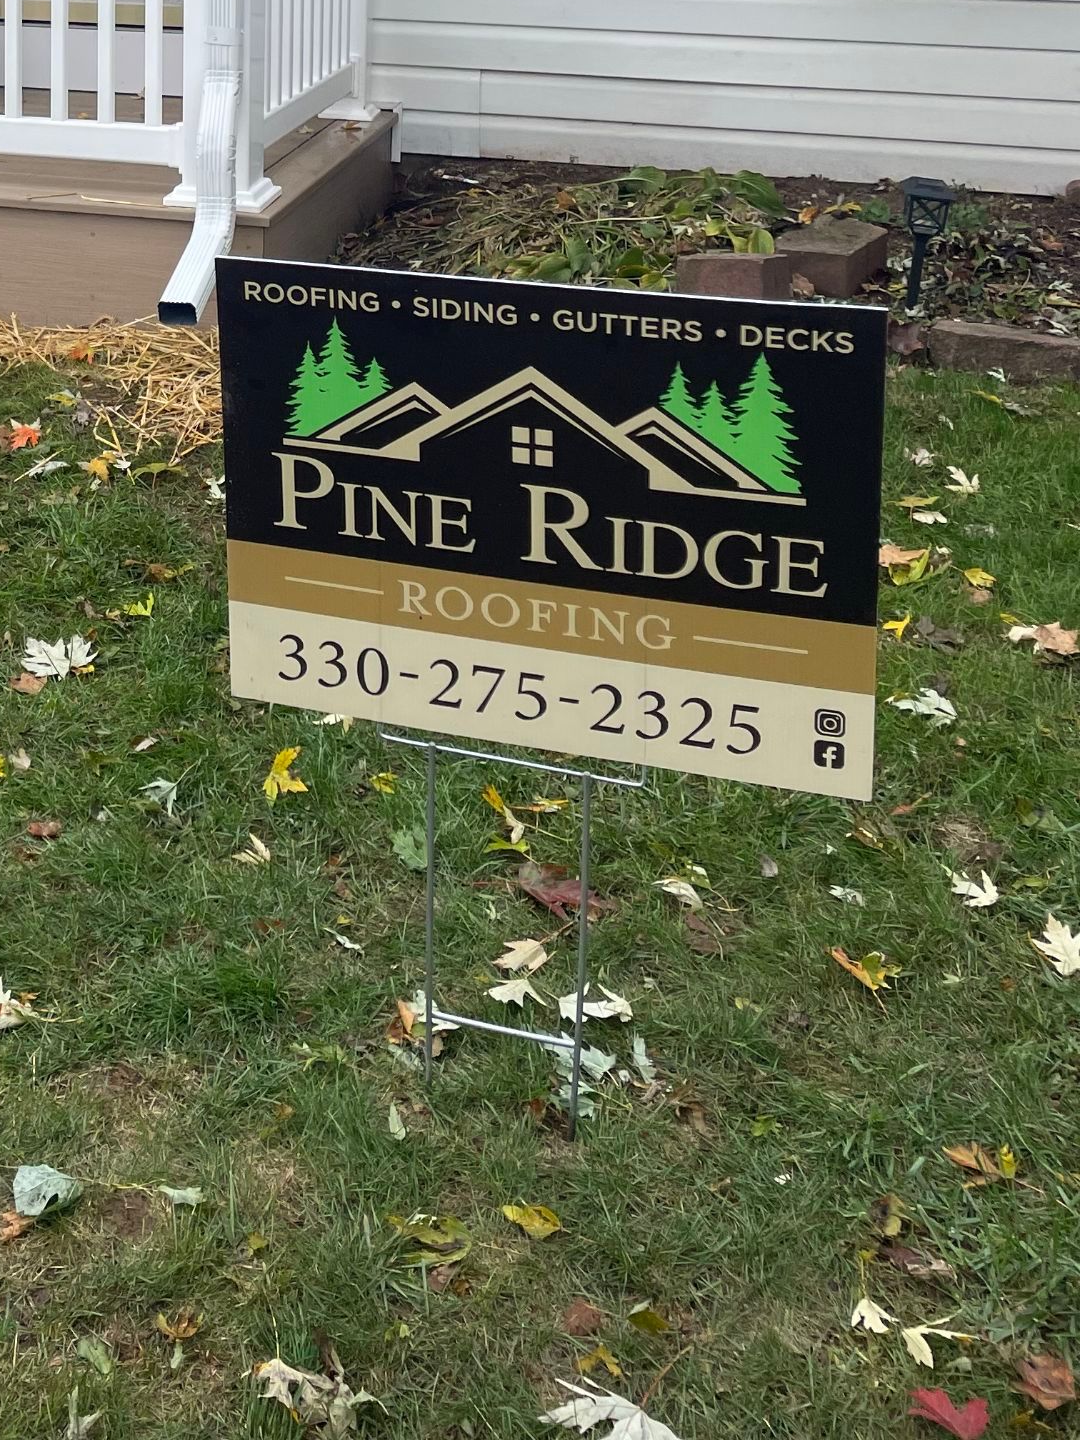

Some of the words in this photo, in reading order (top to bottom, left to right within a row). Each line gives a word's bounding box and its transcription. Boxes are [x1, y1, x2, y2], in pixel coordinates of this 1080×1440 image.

[243, 281, 380, 313] ROOFING
[412, 295, 519, 326] SIDING
[552, 309, 702, 343] GUTTERS
[739, 324, 855, 355] DECKS
[272, 451, 476, 553] PINE
[520, 483, 828, 599] RIDGE
[397, 579, 677, 651] ROOFING
[276, 634, 762, 755] 330-275-2325
